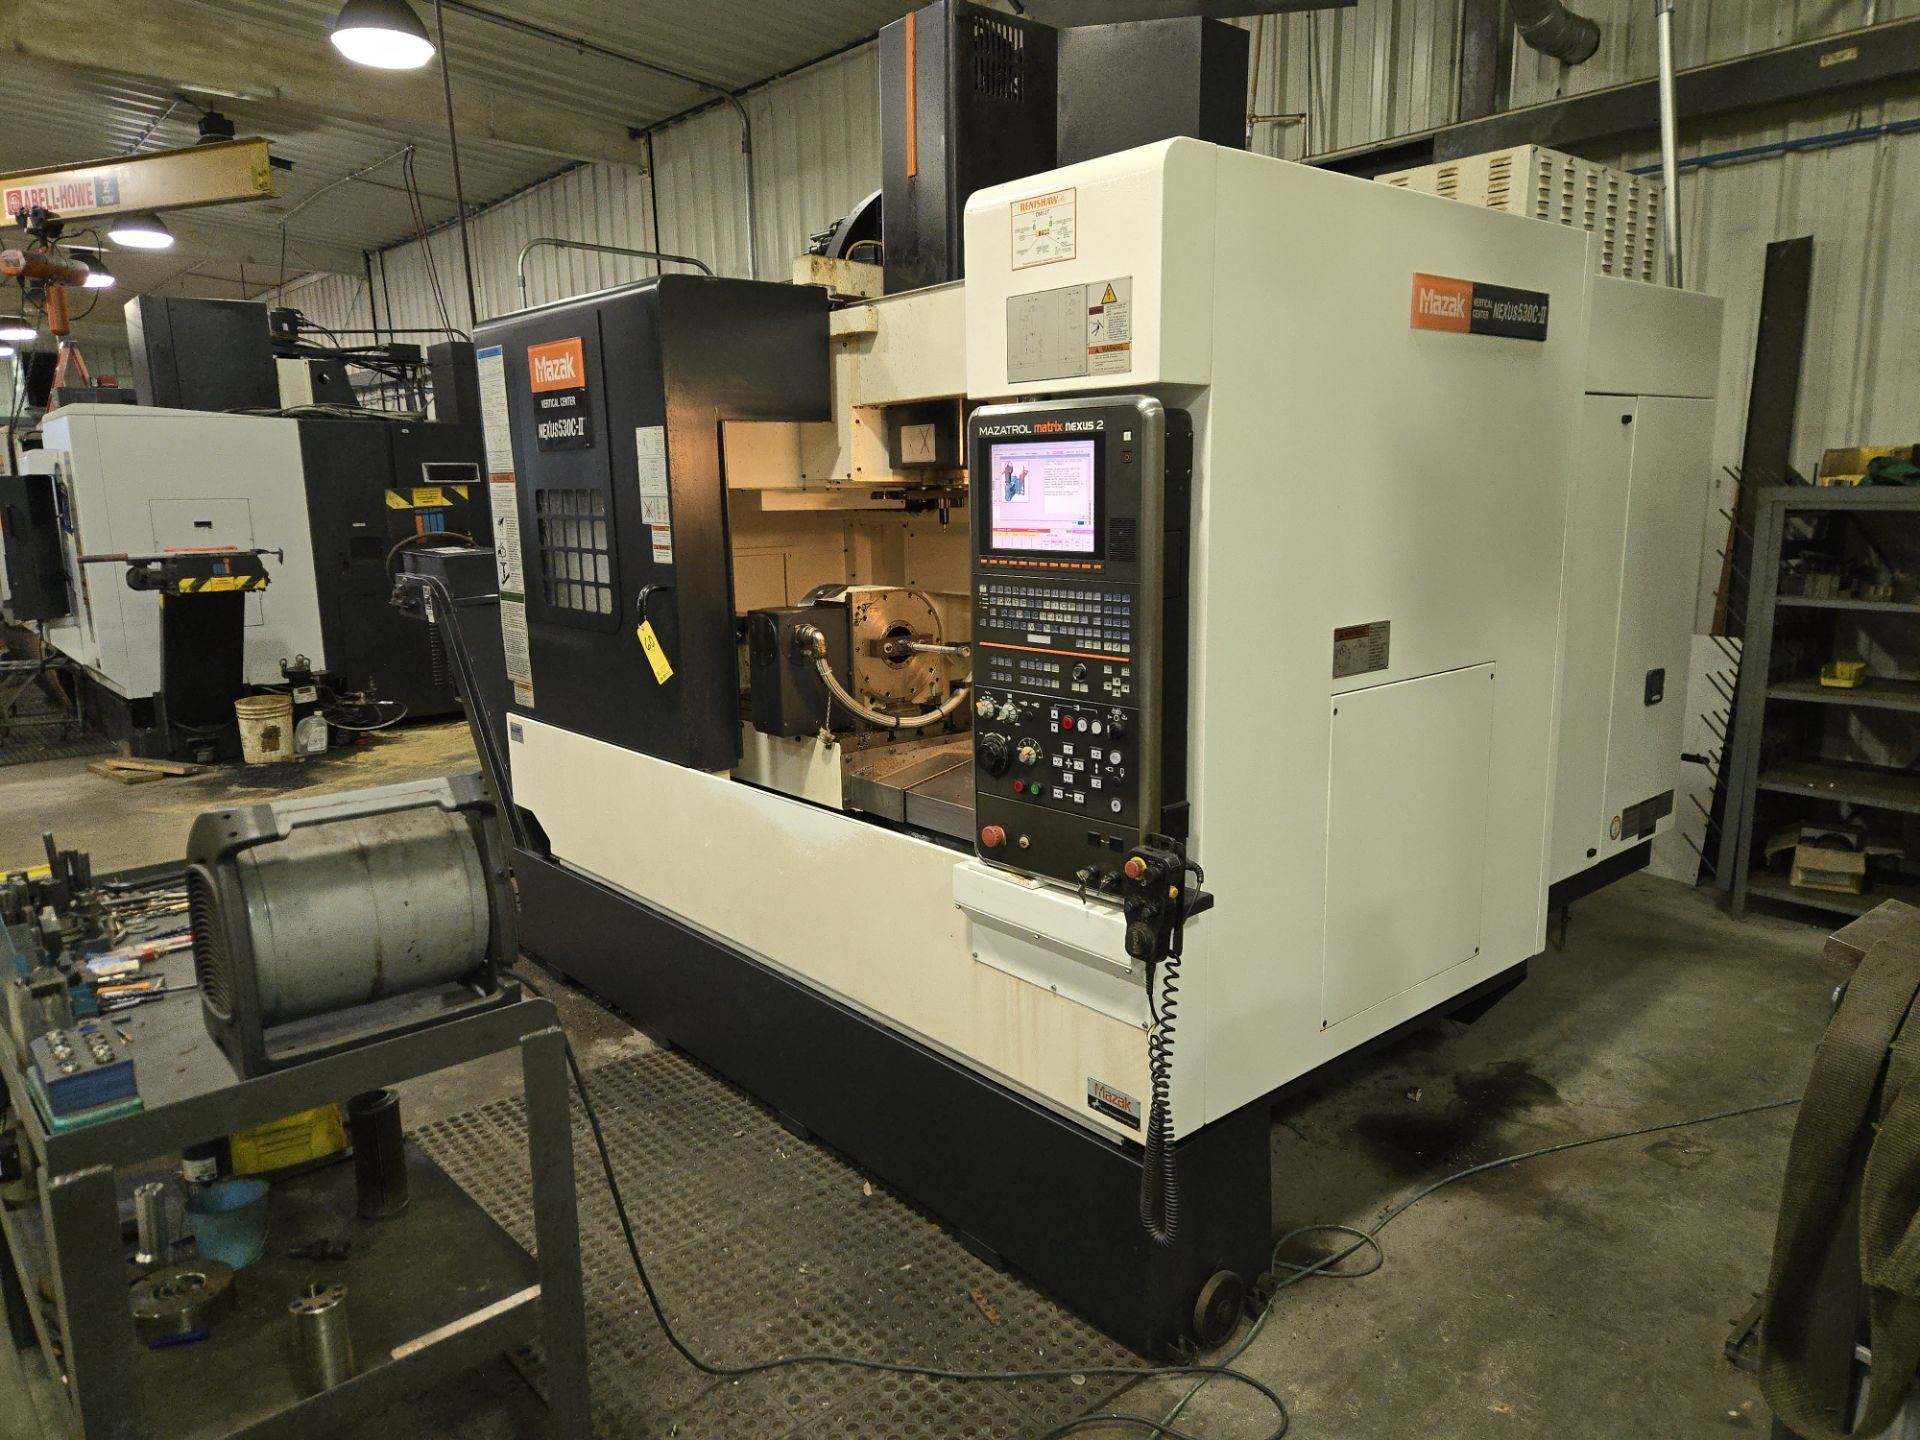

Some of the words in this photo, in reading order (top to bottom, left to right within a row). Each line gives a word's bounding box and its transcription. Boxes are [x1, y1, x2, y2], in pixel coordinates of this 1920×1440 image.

[1020, 195, 1058, 212] RENISHAW
[1419, 287, 1466, 319] Mazak
[1473, 298, 1493, 309] VERTICAL
[1472, 309, 1490, 320] CENTER
[534, 352, 577, 384] Mazak
[541, 399, 560, 409] VERTICAL
[560, 396, 576, 407] CENTER
[979, 424, 1032, 436] MAZATROL
[1033, 421, 1063, 433] matrix
[1096, 419, 1104, 430] 2
[1093, 1082, 1132, 1112] Mazak
